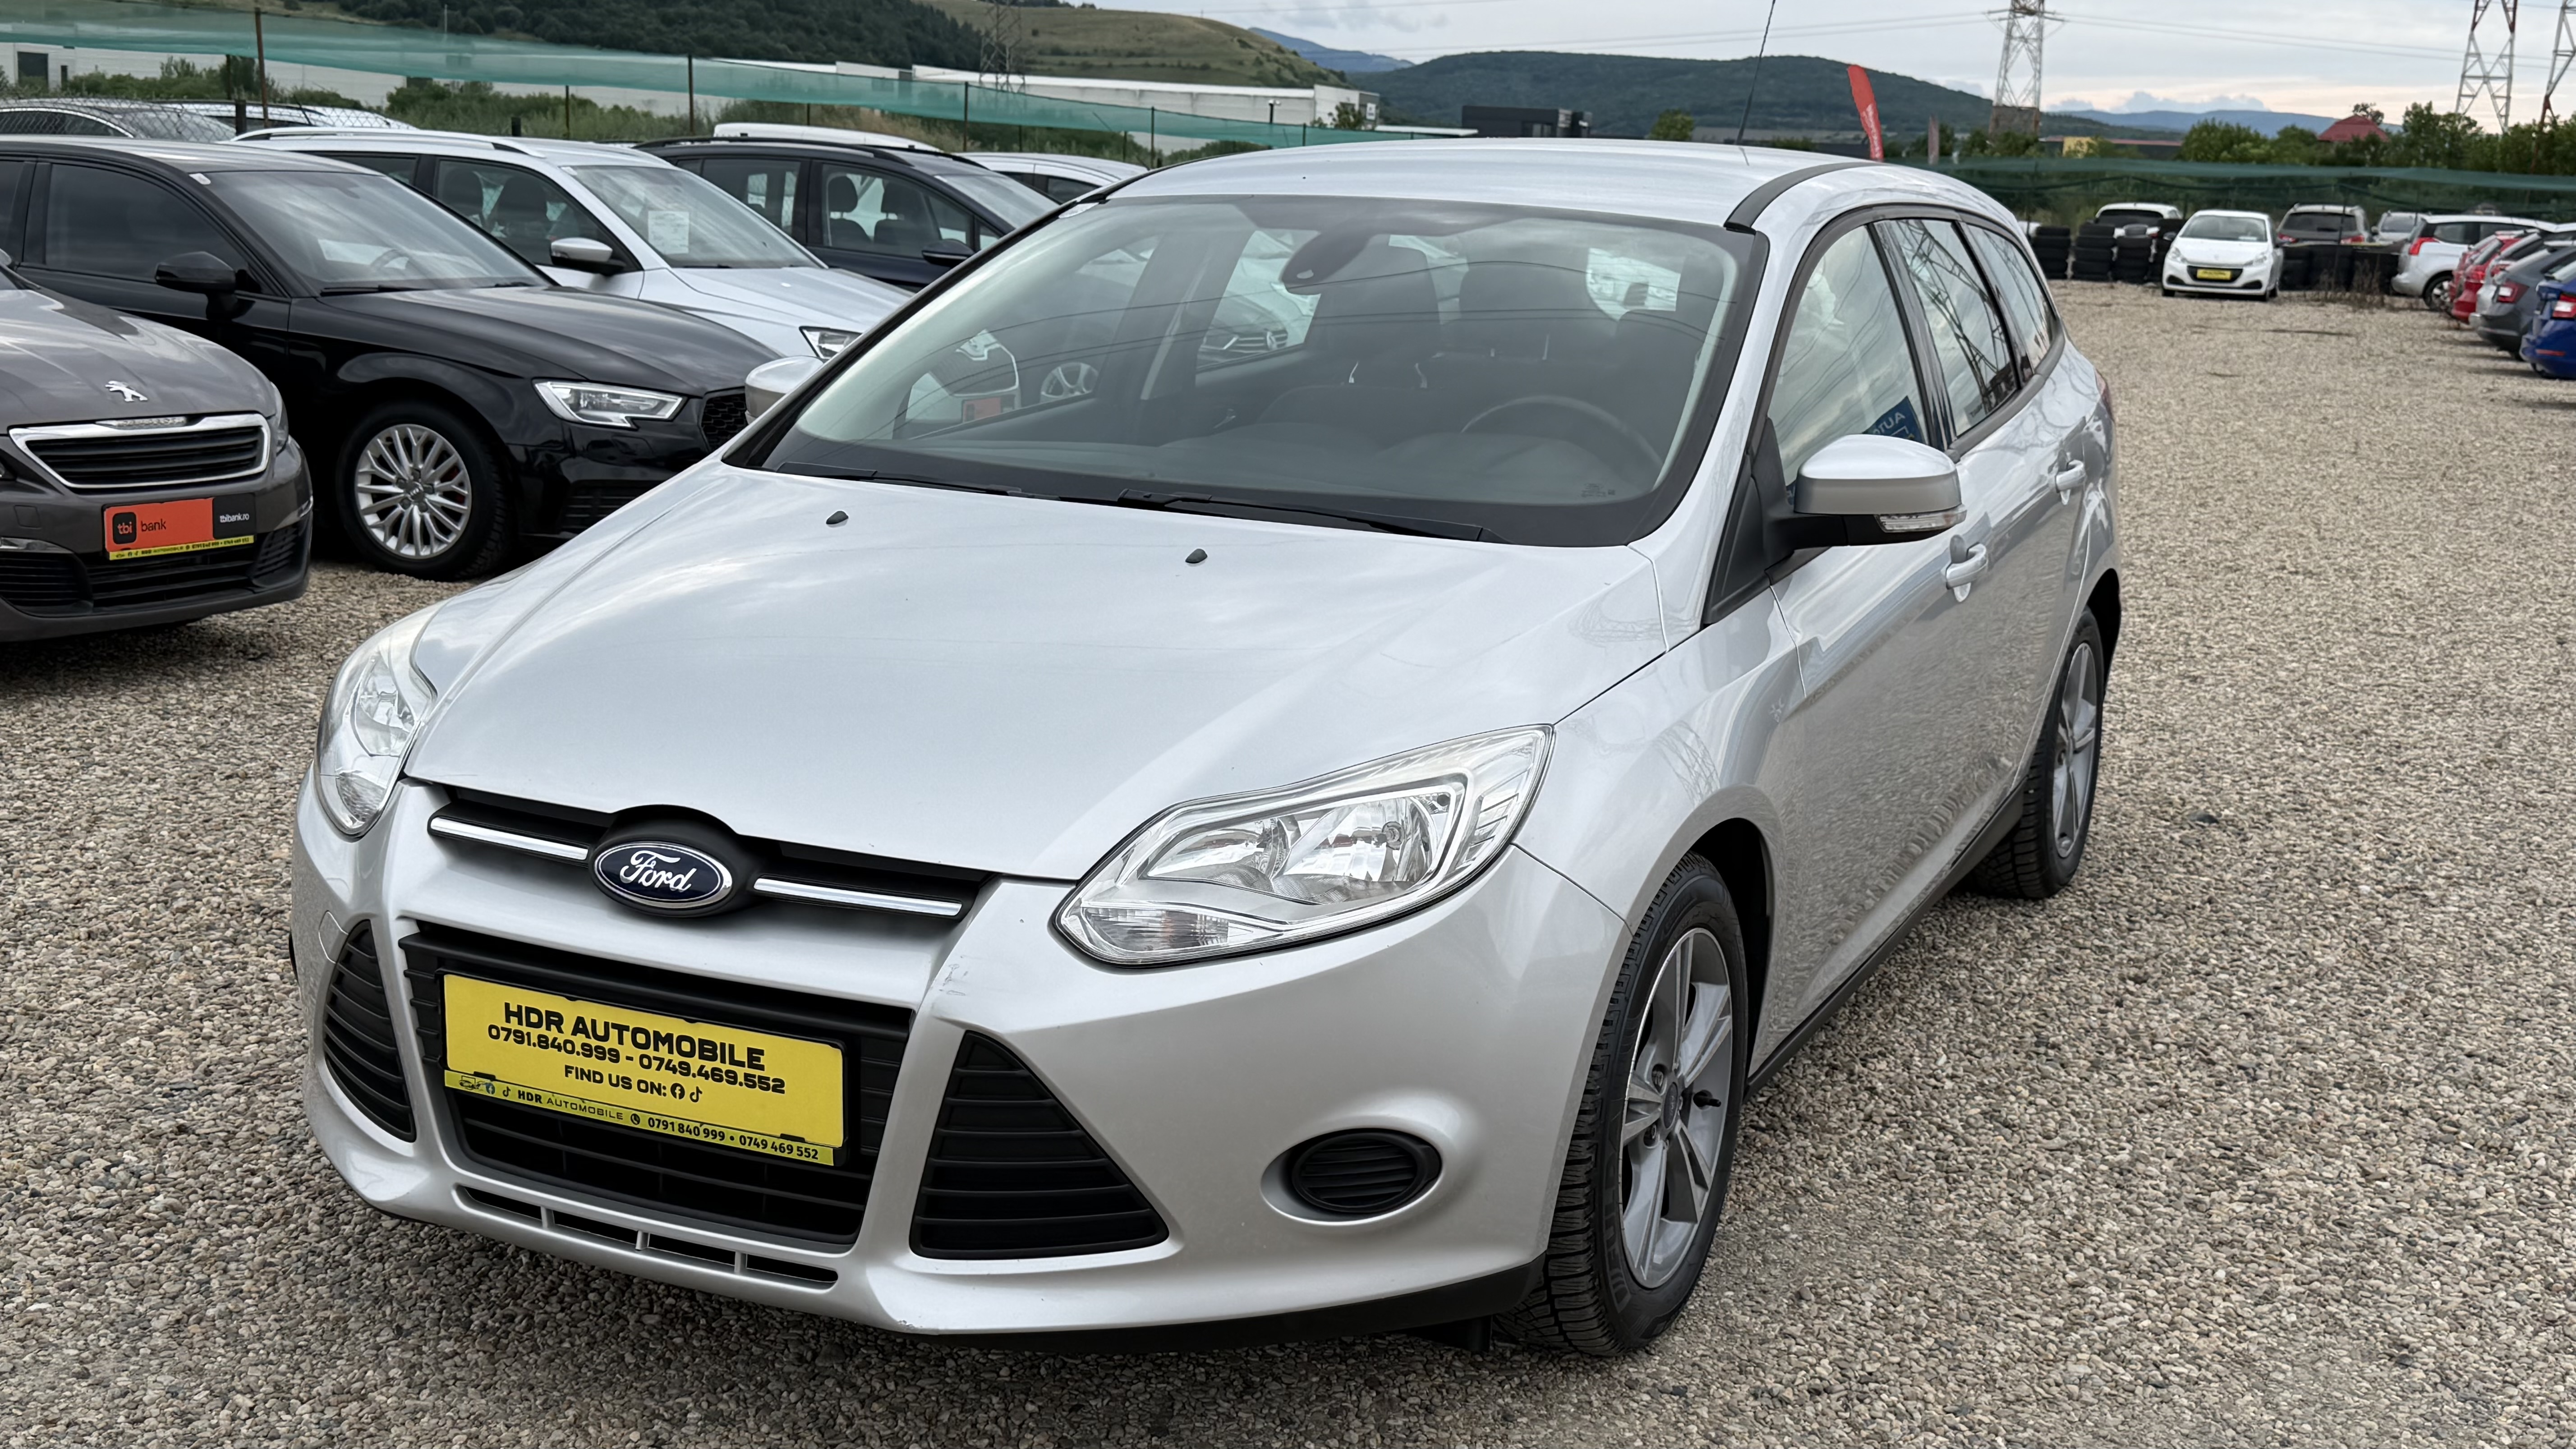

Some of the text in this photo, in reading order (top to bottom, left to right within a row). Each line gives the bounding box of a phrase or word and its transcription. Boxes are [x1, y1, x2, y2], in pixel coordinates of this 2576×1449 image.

[117, 518, 166, 535] tbi bank
[219, 513, 250, 524] tbibank.ro
[620, 850, 697, 893] Ford
[504, 1002, 765, 1072] HDR AUTOMOBILE
[488, 1024, 620, 1063] 0791.840.999
[639, 1053, 786, 1095] 0749.469.552
[565, 1065, 667, 1097] FIND US ON:
[518, 1090, 819, 1160] HDR AUTOMOBILE 0791 840 999 0749 469 552
